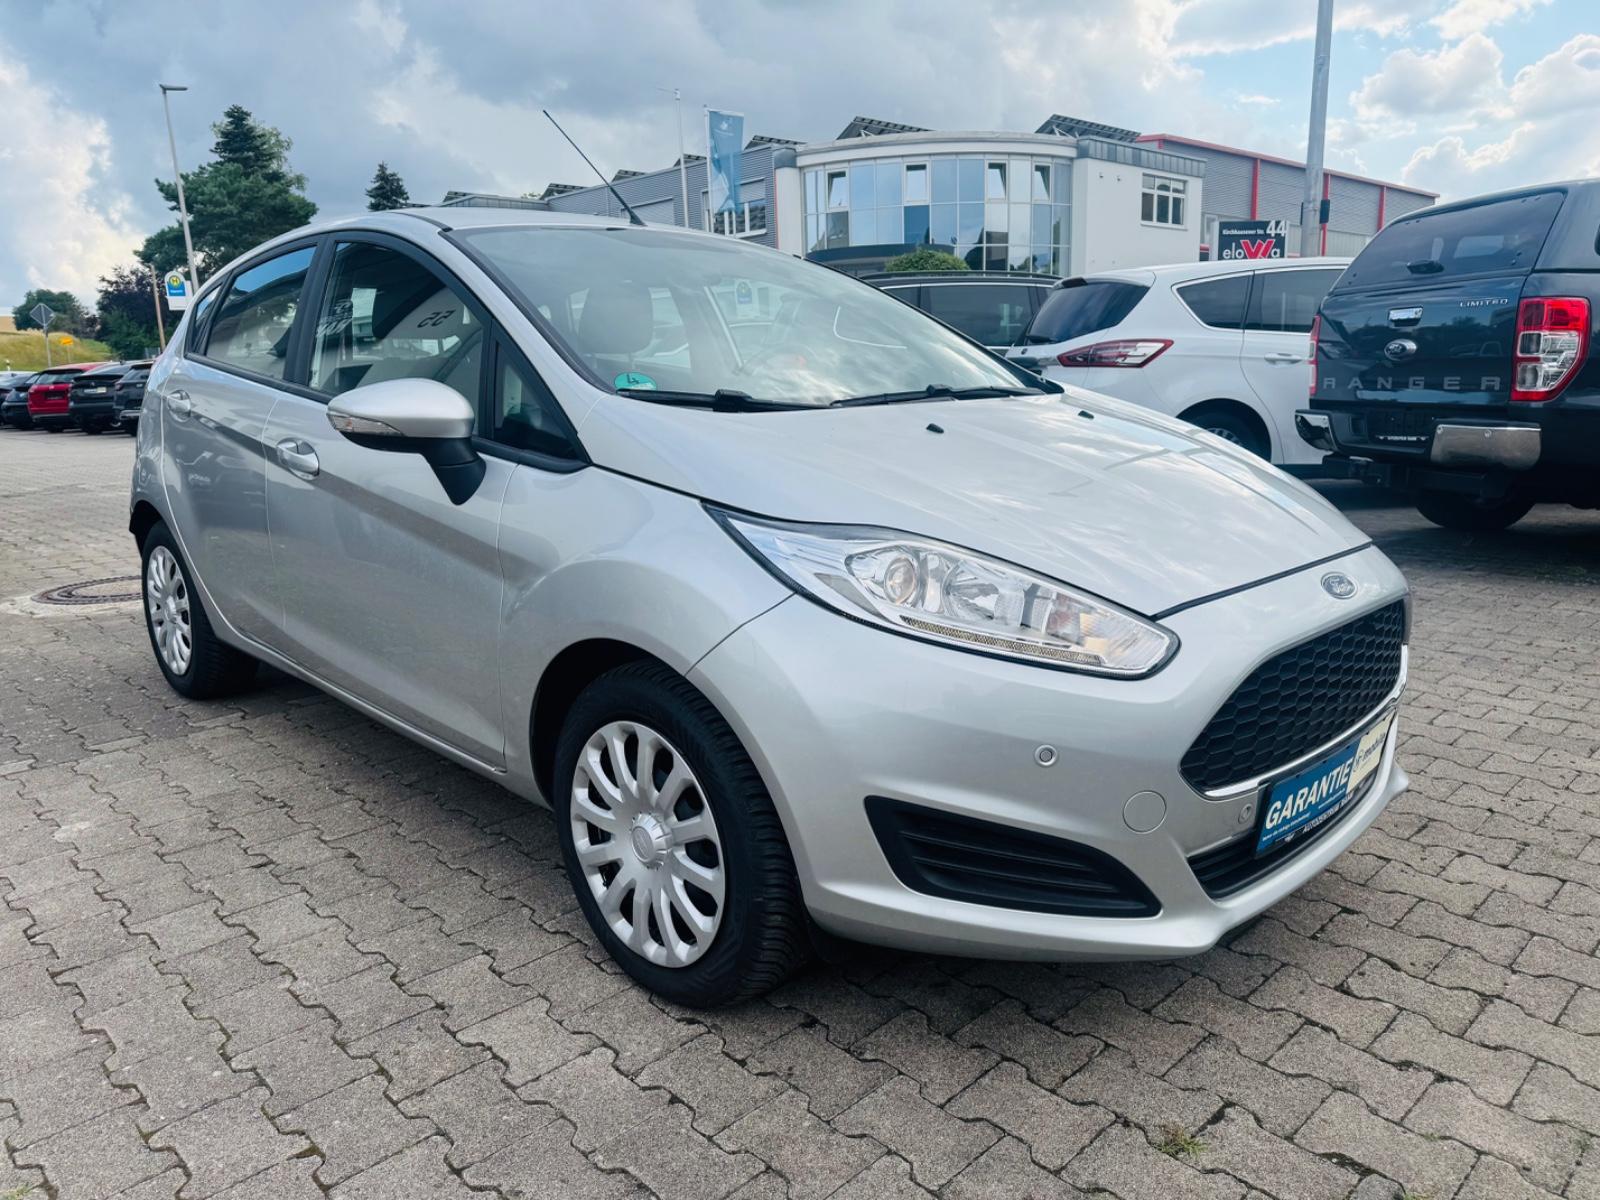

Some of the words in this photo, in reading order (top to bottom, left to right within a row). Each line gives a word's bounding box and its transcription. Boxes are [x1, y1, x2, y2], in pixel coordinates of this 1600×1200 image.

[1266, 220, 1288, 237] 44
[1460, 299, 1508, 307] LIMITED
[1323, 376, 1501, 391] RANGER
[1265, 756, 1354, 830] GARANTIE
